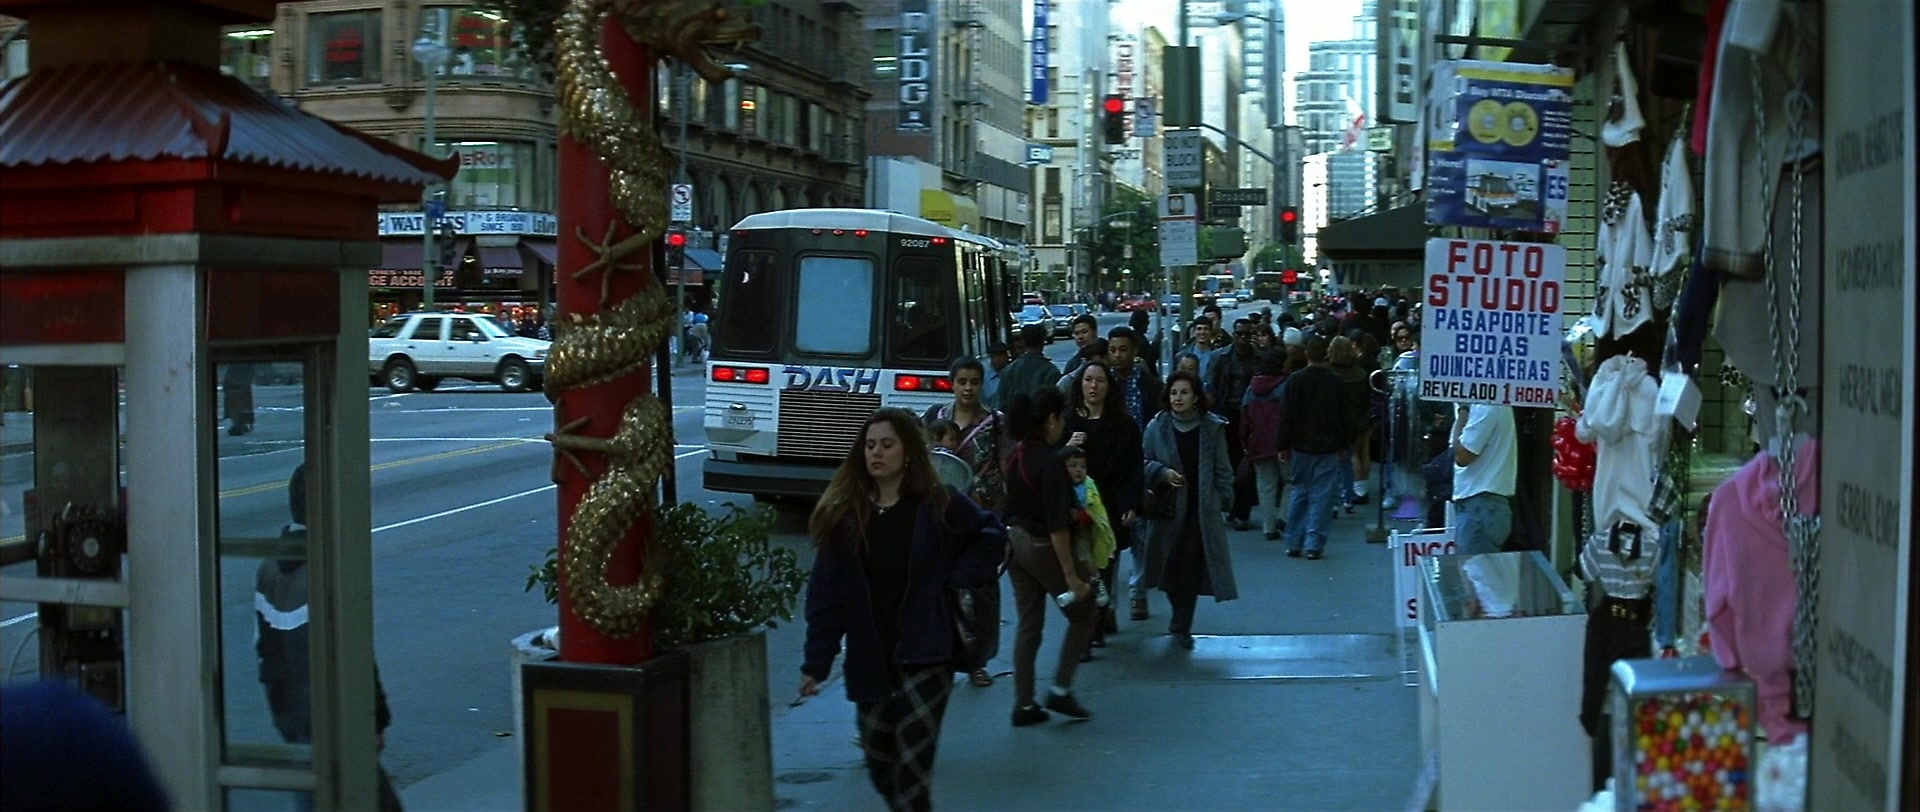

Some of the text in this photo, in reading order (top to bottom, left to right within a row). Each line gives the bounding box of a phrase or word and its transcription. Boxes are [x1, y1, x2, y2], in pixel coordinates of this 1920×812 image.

[1166, 153, 1199, 166] BLOCK
[390, 216, 464, 230] WATS
[900, 238, 930, 248] 92087
[1448, 242, 1543, 278] FOTO
[390, 275, 453, 286] ACCOT
[1429, 274, 1559, 313] STUDIO
[1435, 309, 1550, 335] PASAPORTE
[1455, 333, 1528, 356] BODAS
[782, 365, 881, 394] DASH
[1429, 355, 1549, 381] QUINCEAÑERAS
[1423, 380, 1554, 404] REVELADO 1 HORA
